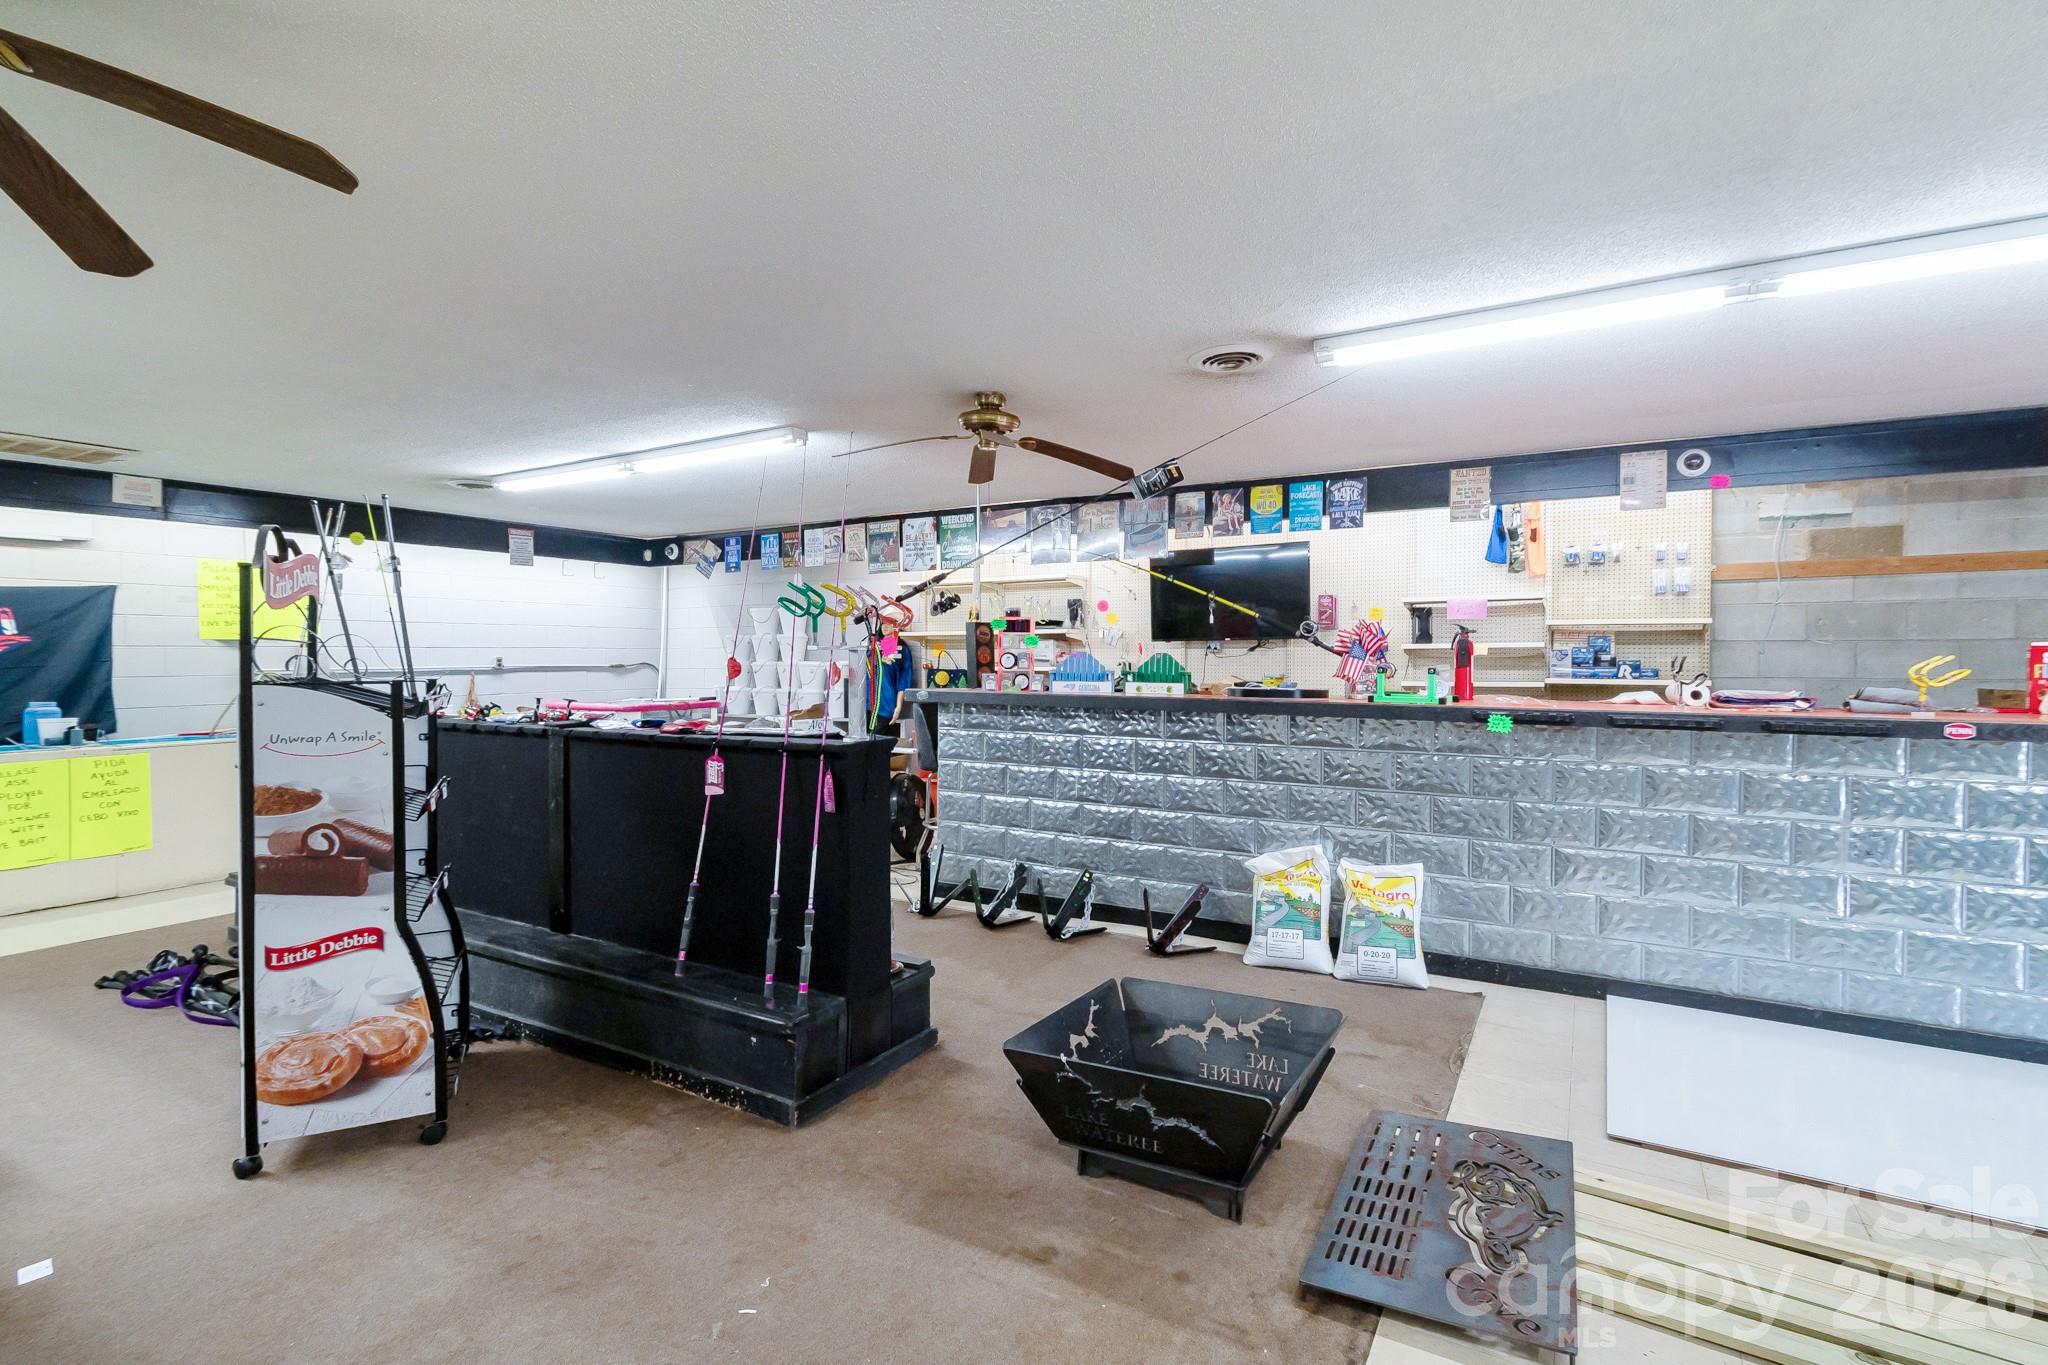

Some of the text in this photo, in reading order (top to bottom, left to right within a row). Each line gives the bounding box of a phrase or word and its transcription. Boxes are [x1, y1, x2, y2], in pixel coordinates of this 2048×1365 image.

[1333, 486, 1360, 501] LAKE
[941, 513, 975, 525] WEEKEND
[269, 571, 293, 599] Little
[269, 730, 377, 746] Unwrap A Smile
[94, 758, 126, 769] PIDA
[90, 769, 129, 781] AYUDA
[4, 779, 29, 788] ASK
[81, 786, 141, 799] EMPLEADO
[7, 802, 32, 812] FOR
[98, 800, 121, 809] CON
[9, 823, 45, 834] WITH
[19, 836, 47, 848] BAIT
[1270, 931, 1300, 941] 17-17-17
[270, 932, 378, 967] Little Debbie
[1363, 950, 1391, 960] 0-20-20
